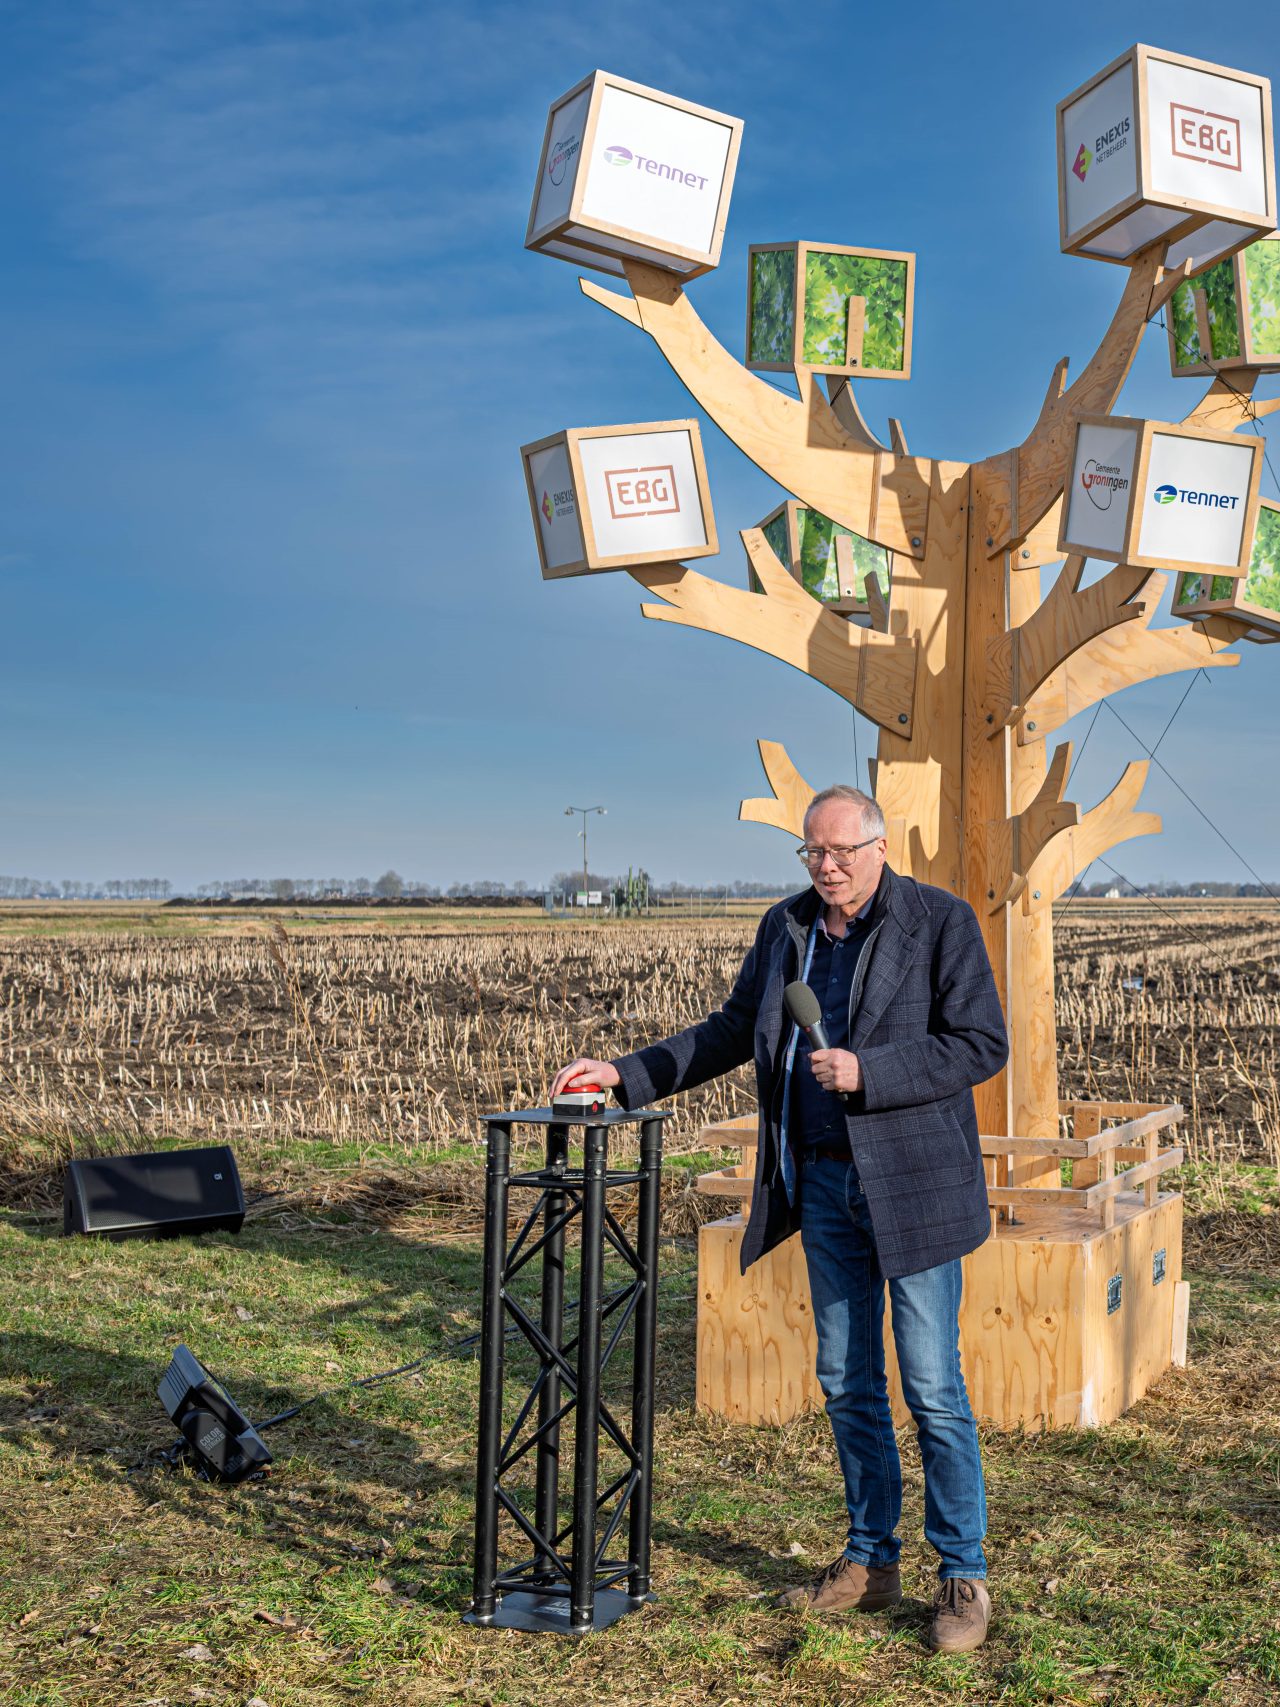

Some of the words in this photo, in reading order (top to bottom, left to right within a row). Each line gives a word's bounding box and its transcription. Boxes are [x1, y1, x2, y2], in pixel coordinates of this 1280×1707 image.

[1095, 117, 1130, 153] ENEXIS
[1181, 118, 1231, 156] EBG
[1095, 137, 1127, 165] NETBEHEER
[1081, 472, 1129, 492] Groningen
[1095, 463, 1121, 475] Gemeente
[616, 478, 669, 506] EBG
[199, 1427, 222, 1447] COLOR
